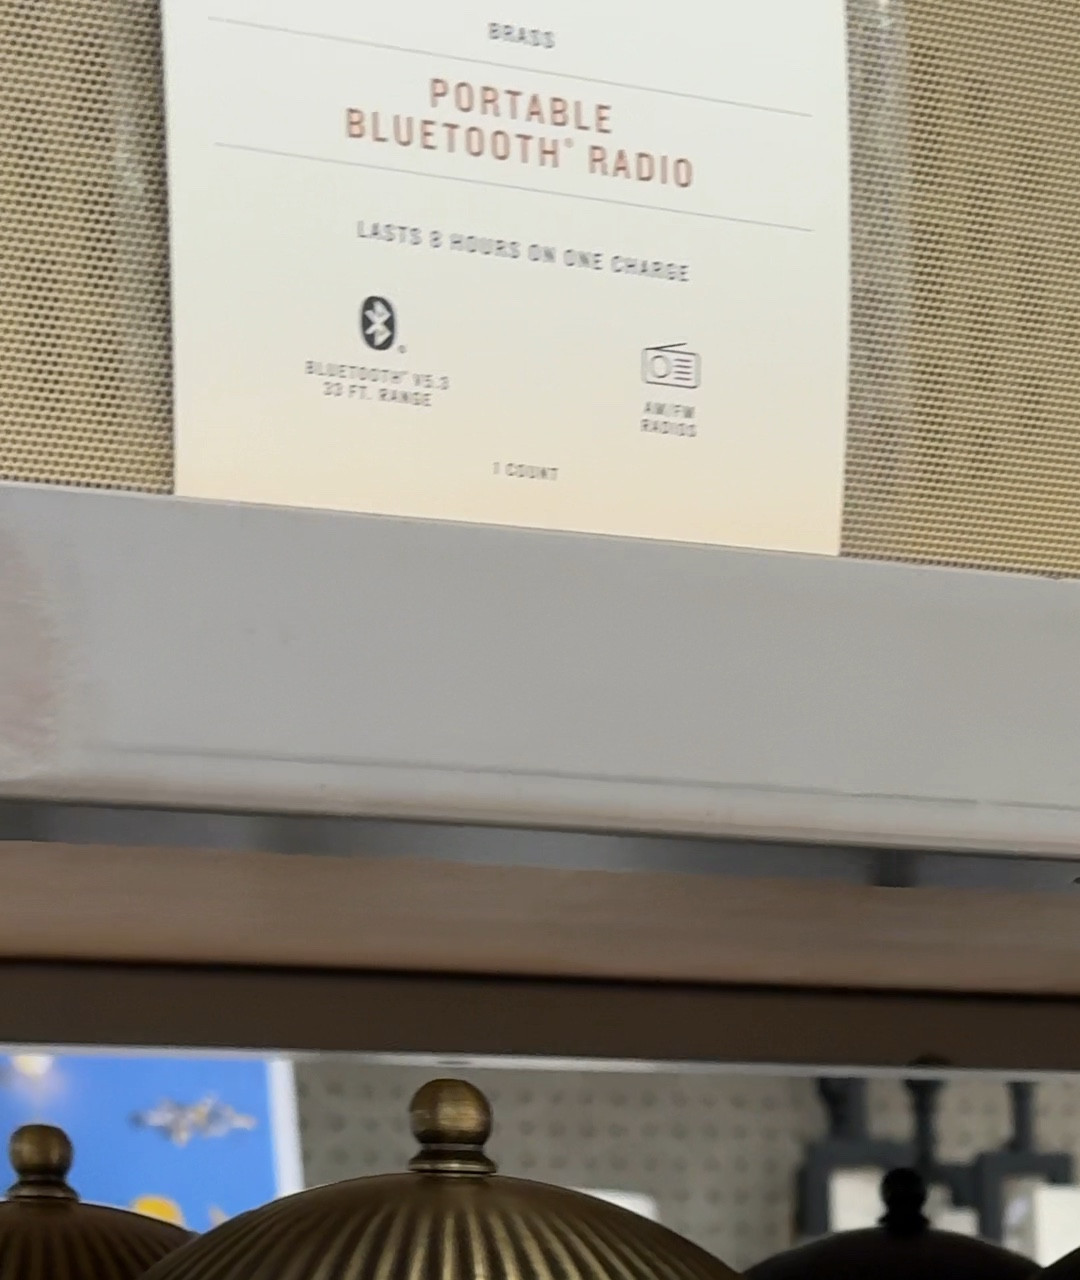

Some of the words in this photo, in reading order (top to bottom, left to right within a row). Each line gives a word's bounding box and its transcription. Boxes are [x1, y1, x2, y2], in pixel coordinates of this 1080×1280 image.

[487, 21, 556, 50] BRASS
[430, 77, 613, 135] PORTABLE
[588, 144, 694, 189] RADIO
[356, 219, 422, 247] LASTS
[429, 229, 444, 249] 8
[449, 232, 522, 261] HOURS
[527, 243, 557, 265] ON
[563, 247, 605, 272] ONE
[610, 254, 691, 283] CHARGE
[323, 381, 344, 397] 33
[348, 384, 372, 401] FT.
[378, 387, 432, 407] RANGE
[505, 462, 560, 481] COUNT
